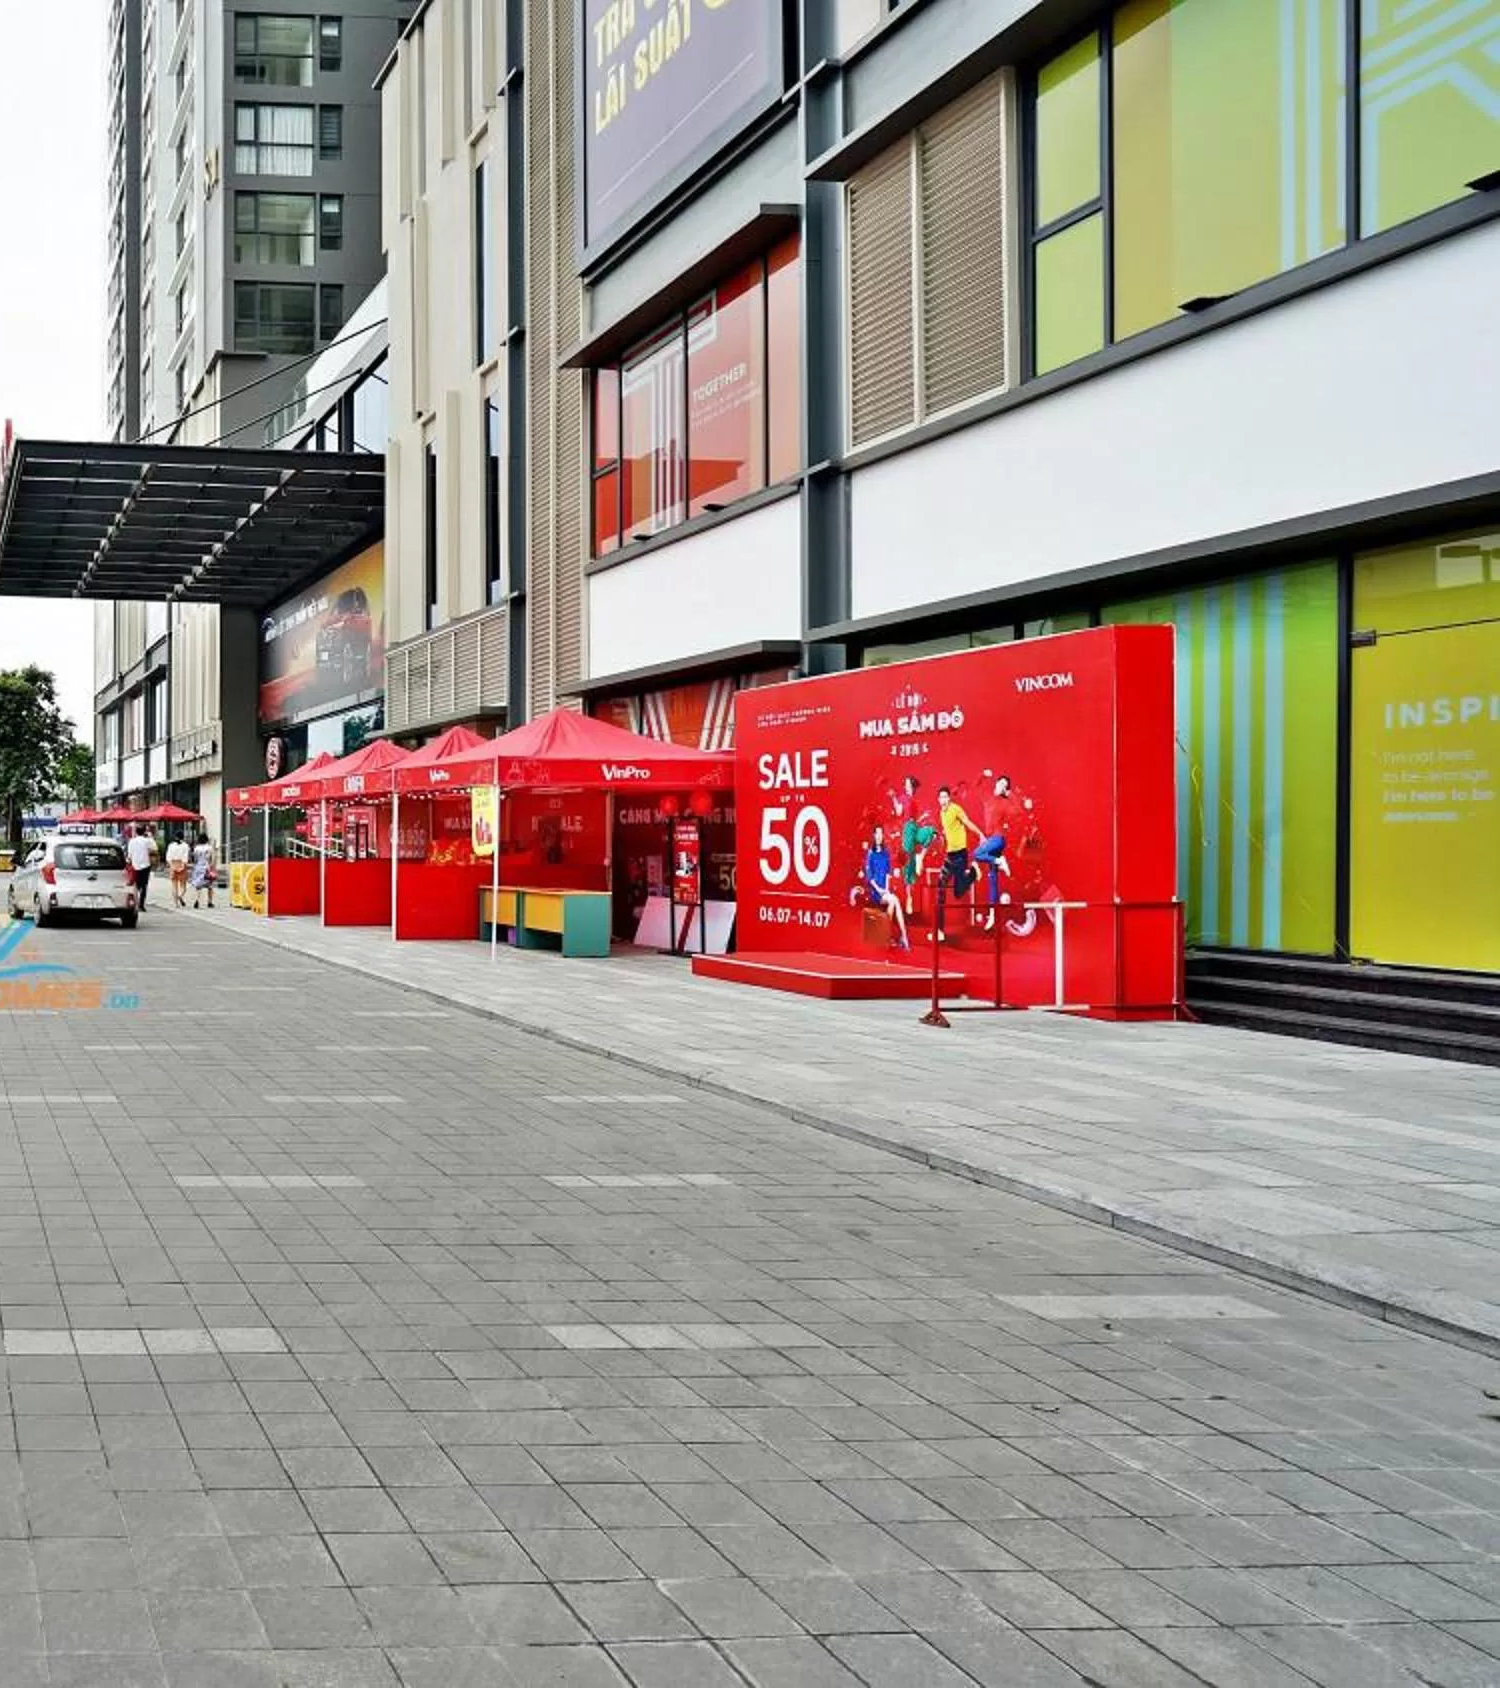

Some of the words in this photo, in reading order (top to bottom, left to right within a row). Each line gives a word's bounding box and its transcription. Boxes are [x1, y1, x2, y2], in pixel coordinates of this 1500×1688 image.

[1015, 671, 1075, 692] VINCOM
[859, 718, 894, 738] MUA
[897, 710, 935, 733] SẮM
[937, 705, 965, 730] ĐỎ
[601, 763, 652, 781] VinPro
[759, 749, 830, 790] SALE
